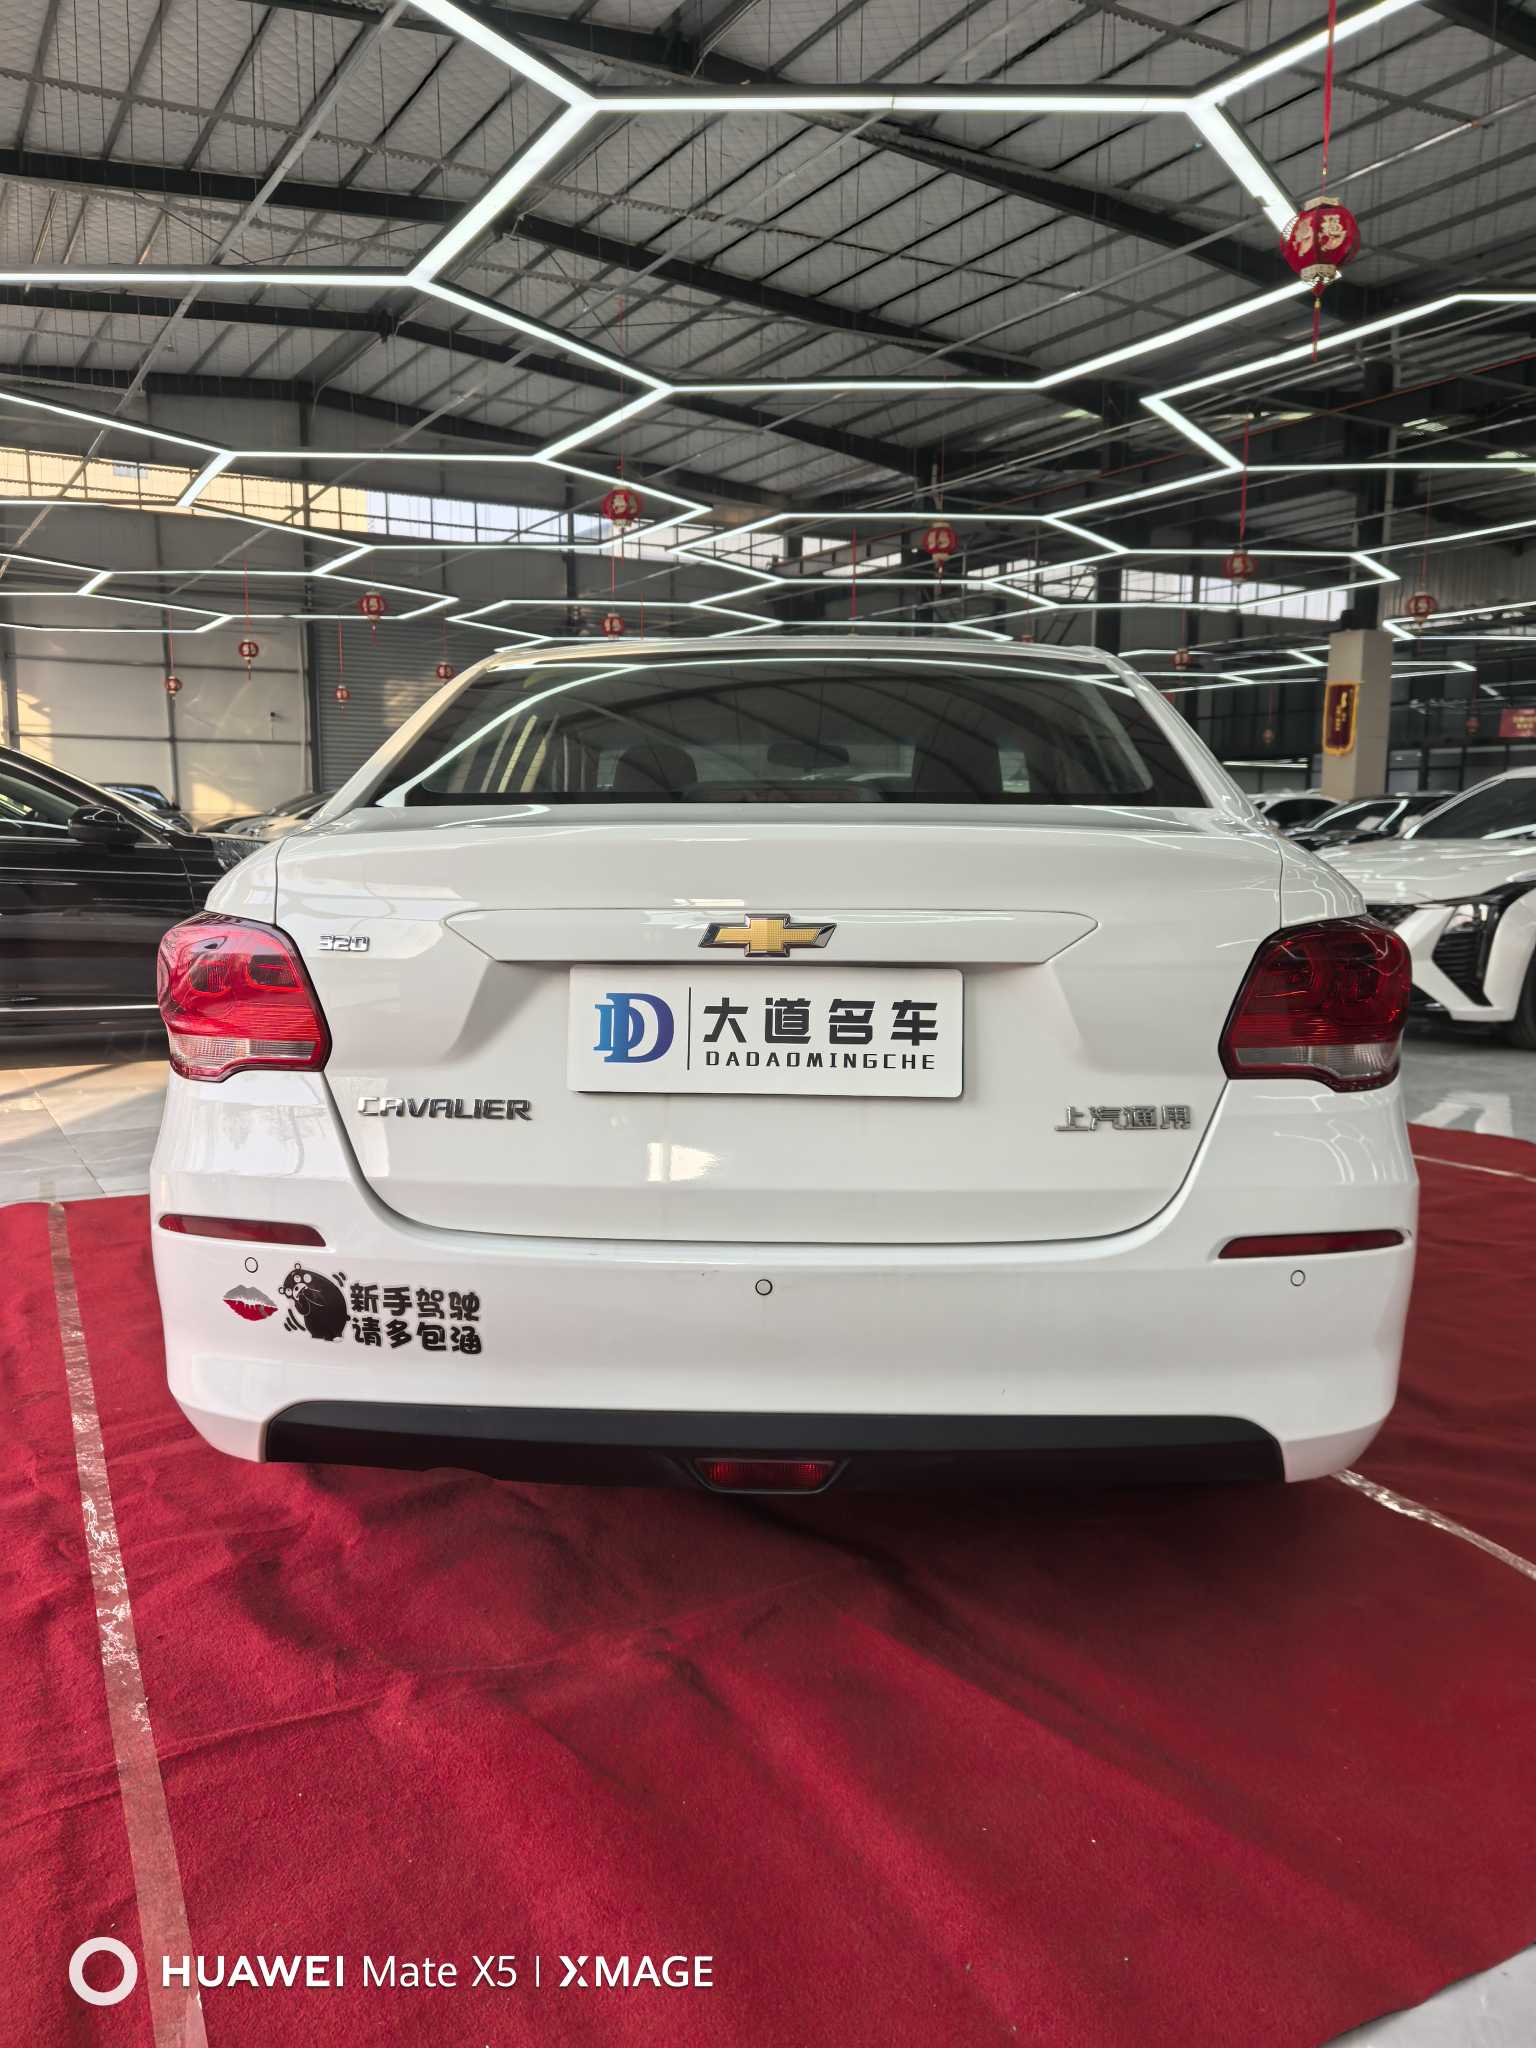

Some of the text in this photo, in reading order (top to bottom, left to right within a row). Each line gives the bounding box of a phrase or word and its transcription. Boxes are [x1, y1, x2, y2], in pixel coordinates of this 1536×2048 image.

[318, 934, 370, 952] 320
[703, 997, 939, 1047] 大道名车
[705, 1051, 936, 1070] DADAOMINGCHE
[357, 1096, 532, 1121] CAVALIER
[1054, 1105, 1192, 1132] 上汽通用
[349, 1282, 481, 1321] 新手驾驶
[351, 1316, 482, 1355] 请多包涵
